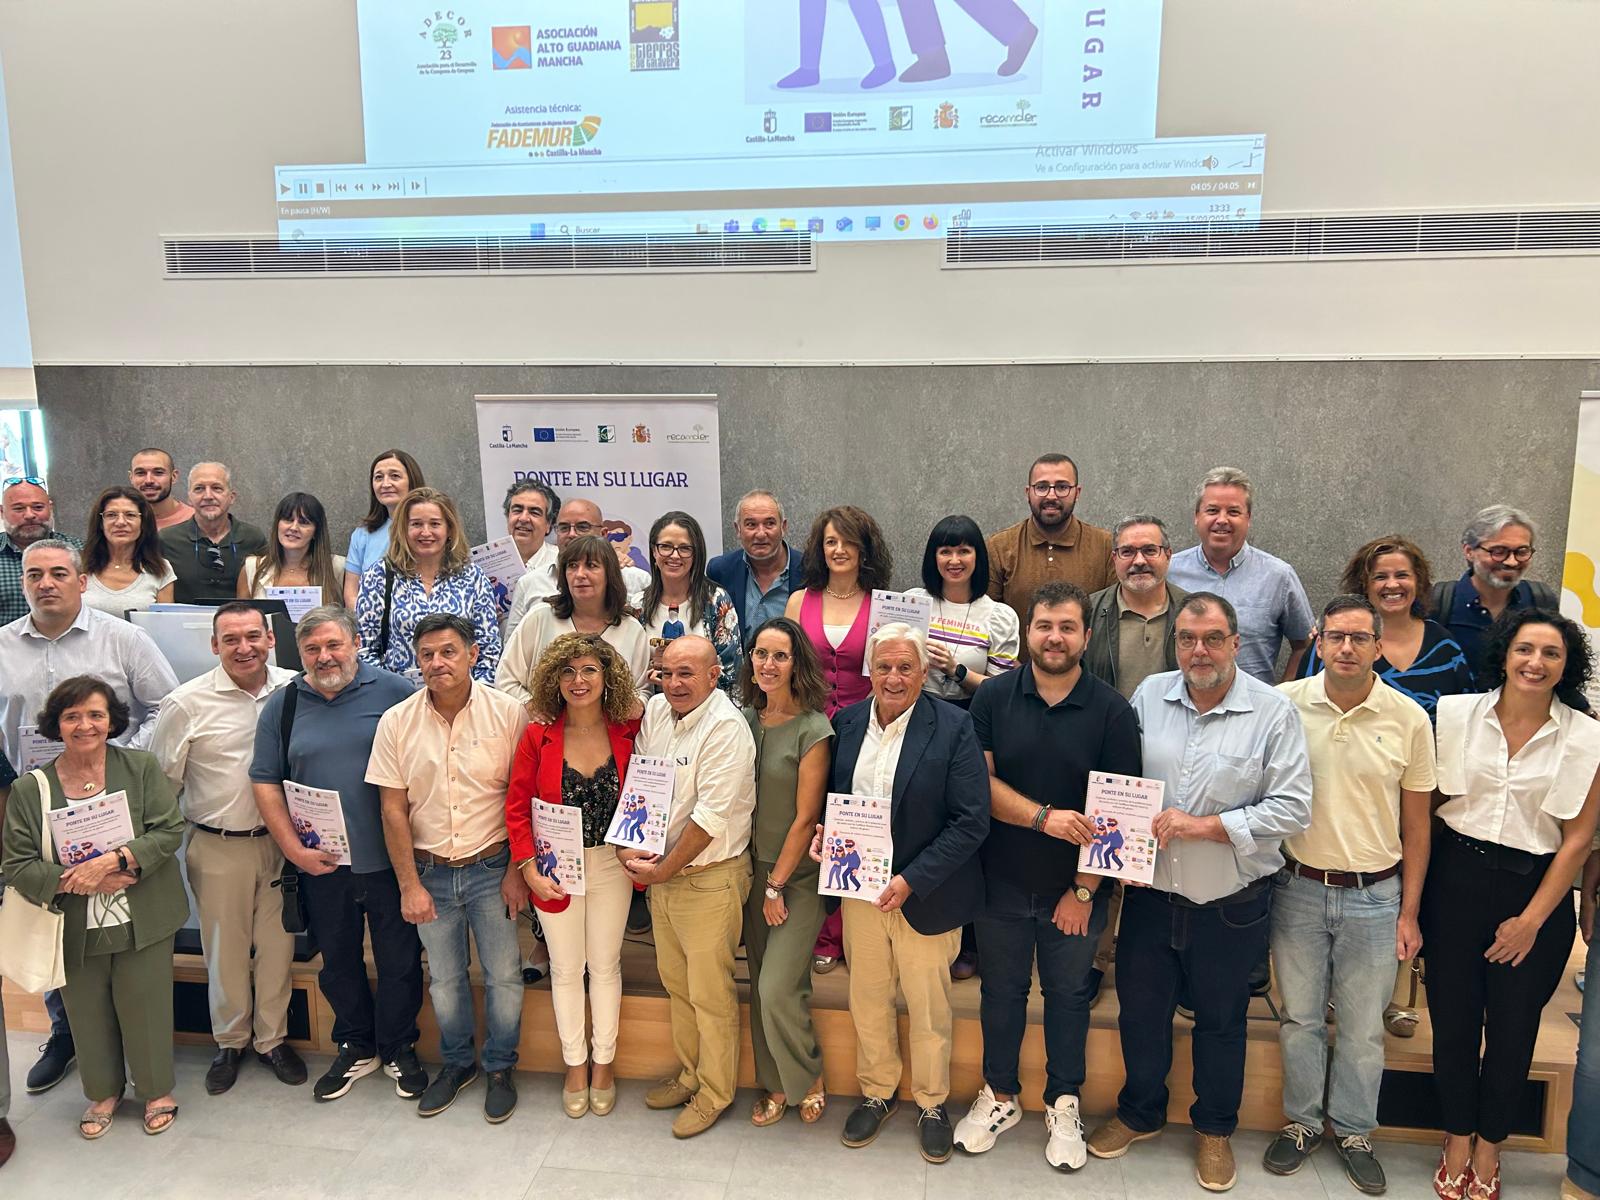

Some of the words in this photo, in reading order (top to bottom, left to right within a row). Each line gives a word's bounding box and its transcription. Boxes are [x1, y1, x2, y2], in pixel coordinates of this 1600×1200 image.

[536, 25, 598, 40] ASOCIACIÓN
[537, 42, 564, 54] ALTO
[567, 40, 622, 52] GUADIANA
[440, 50, 452, 60] 23
[538, 55, 583, 67] MANCHA
[505, 104, 547, 114] Asistencia
[549, 103, 582, 113] técnica:
[487, 127, 573, 149] FADEMUR
[1035, 144, 1076, 157] Activar
[1081, 143, 1139, 156] Windows
[1056, 161, 1118, 174] Configuración
[1120, 162, 1141, 173] para
[1142, 159, 1172, 170] activar
[1209, 203, 1231, 212] 13:33
[575, 225, 600, 234] Buscar
[575, 471, 599, 487] EN
[603, 471, 627, 487] SU
[630, 471, 689, 488] LUGAR
[937, 617, 981, 632] FEMINISTA
